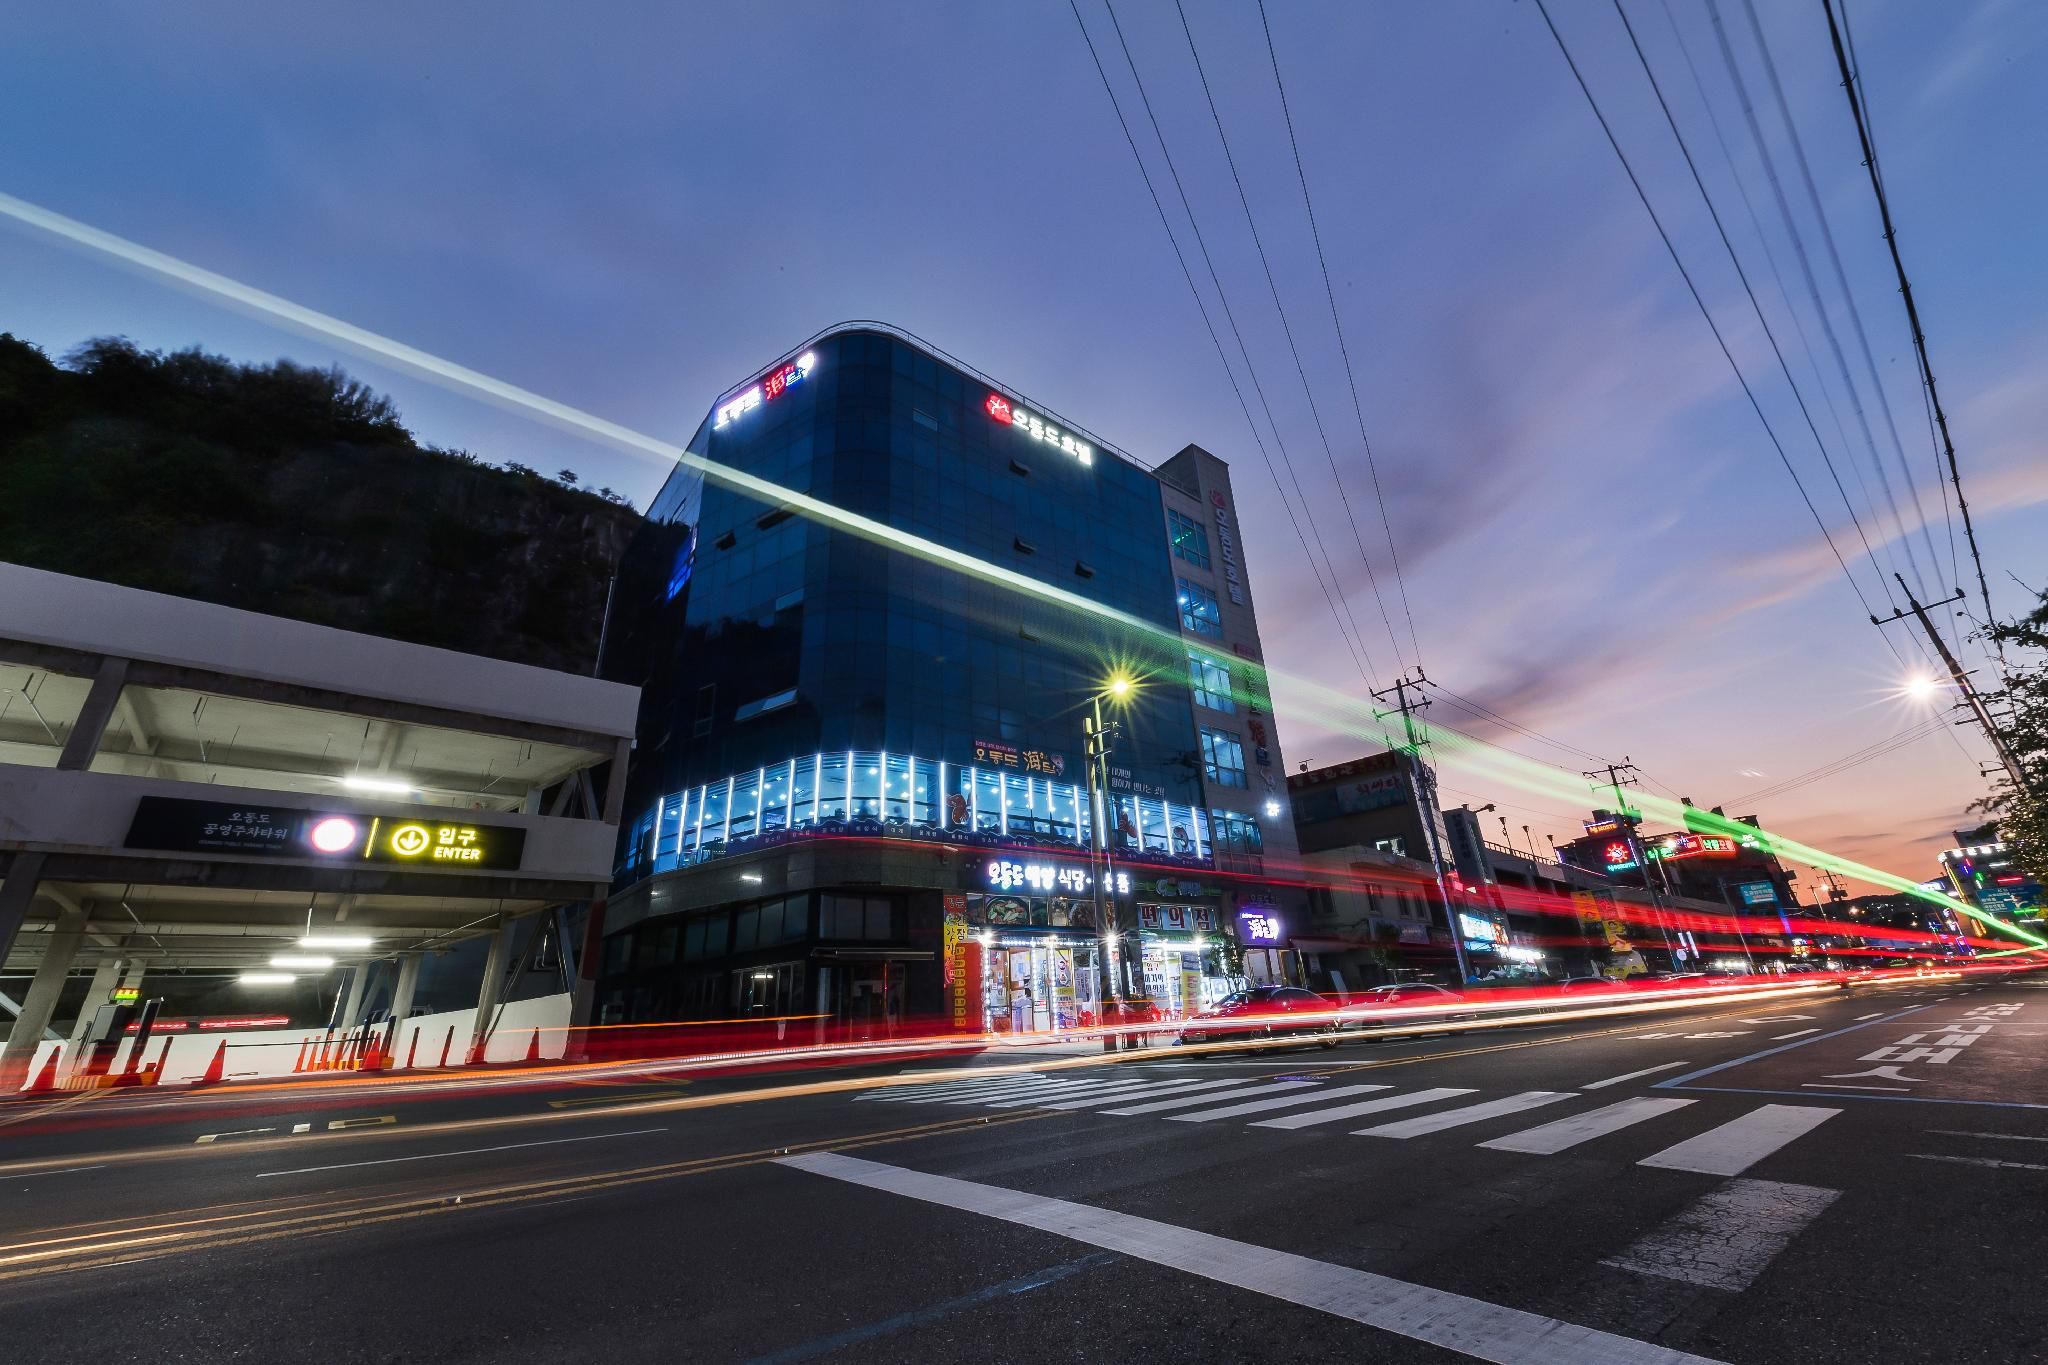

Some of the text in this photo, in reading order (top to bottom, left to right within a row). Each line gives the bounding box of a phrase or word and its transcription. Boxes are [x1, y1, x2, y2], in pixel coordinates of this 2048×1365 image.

[228, 812, 271, 824] 오동도
[203, 823, 288, 840] 공영주차타워
[439, 828, 477, 846] 입구
[434, 847, 481, 860] ENTER
[988, 861, 1024, 889] 오동도
[1141, 905, 1210, 930] 편의점
